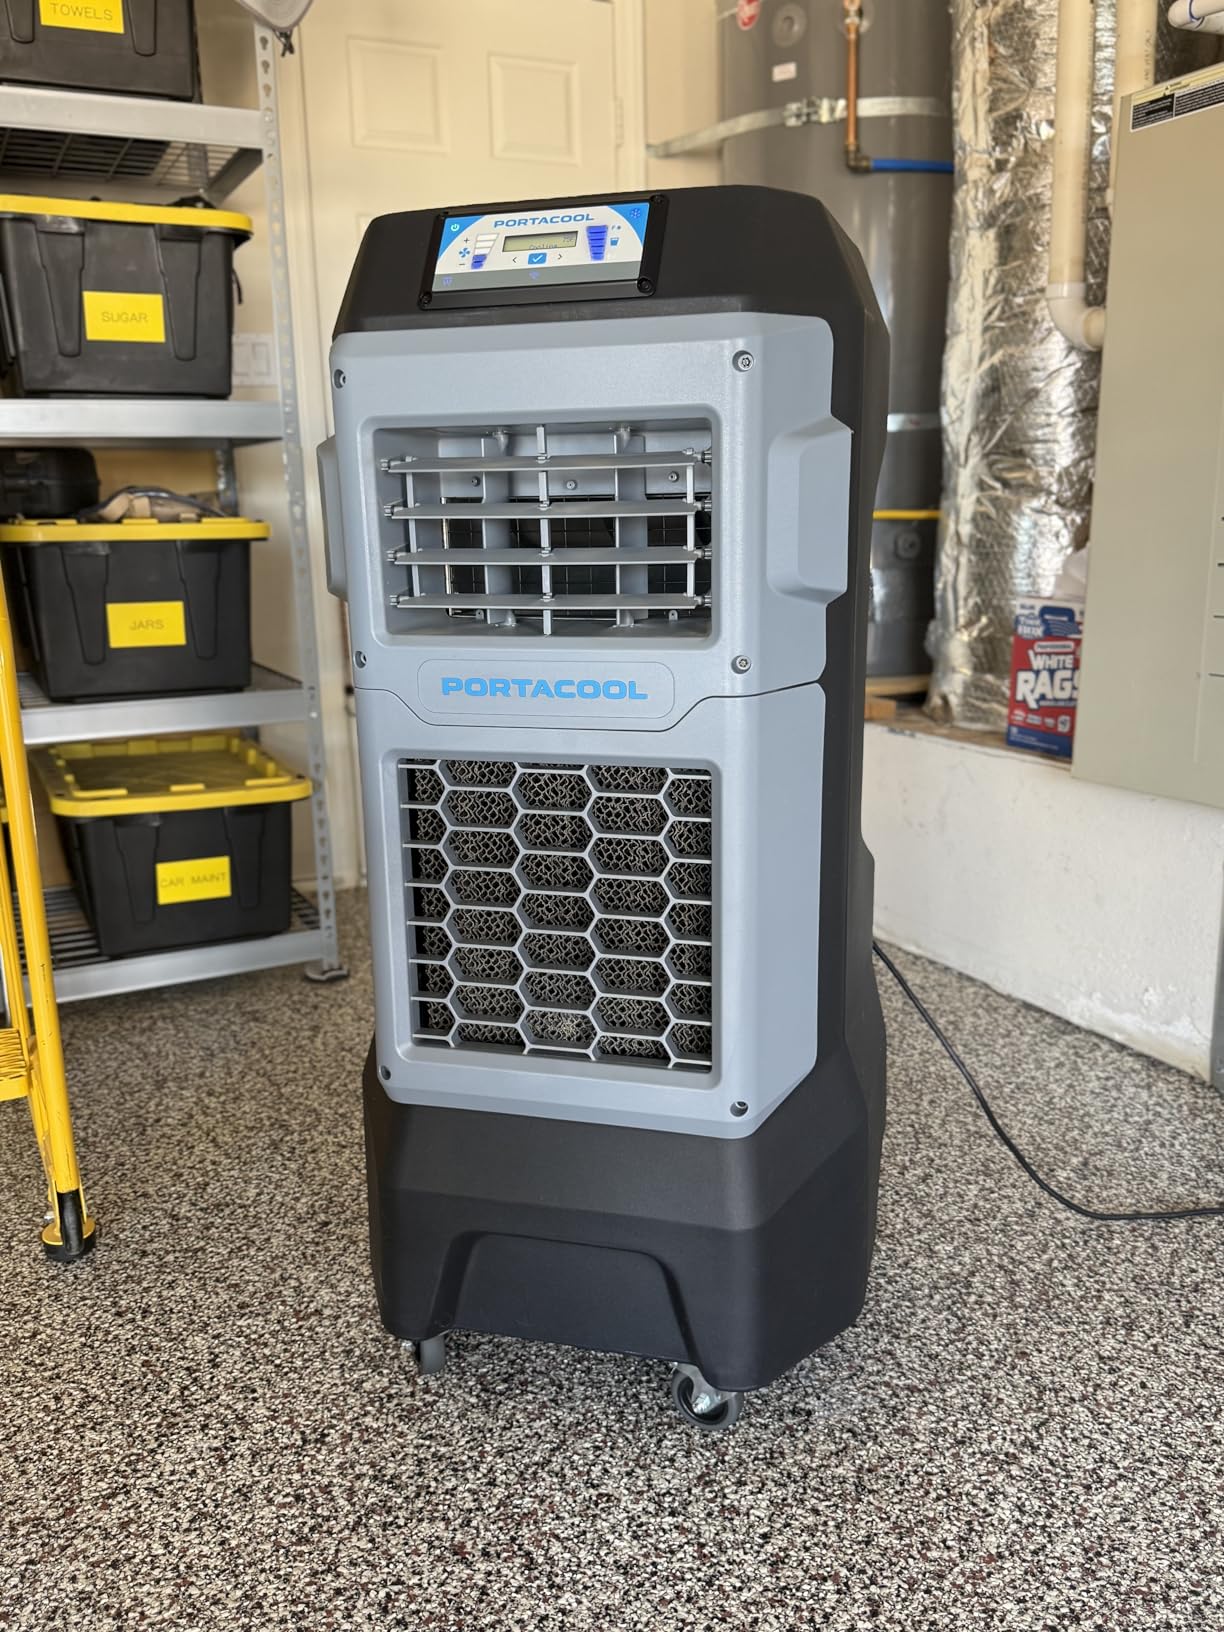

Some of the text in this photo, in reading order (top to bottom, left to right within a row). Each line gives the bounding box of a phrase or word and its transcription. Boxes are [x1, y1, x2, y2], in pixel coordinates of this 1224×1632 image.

[49, 2, 113, 21] TOWELS
[494, 213, 594, 228] PORTACOOL
[102, 311, 149, 323] SUGAR
[129, 618, 165, 631] JARS
[1028, 649, 1074, 670] WHITE
[441, 677, 649, 700] PORTACOOL
[160, 870, 228, 889] CAR MAINT
